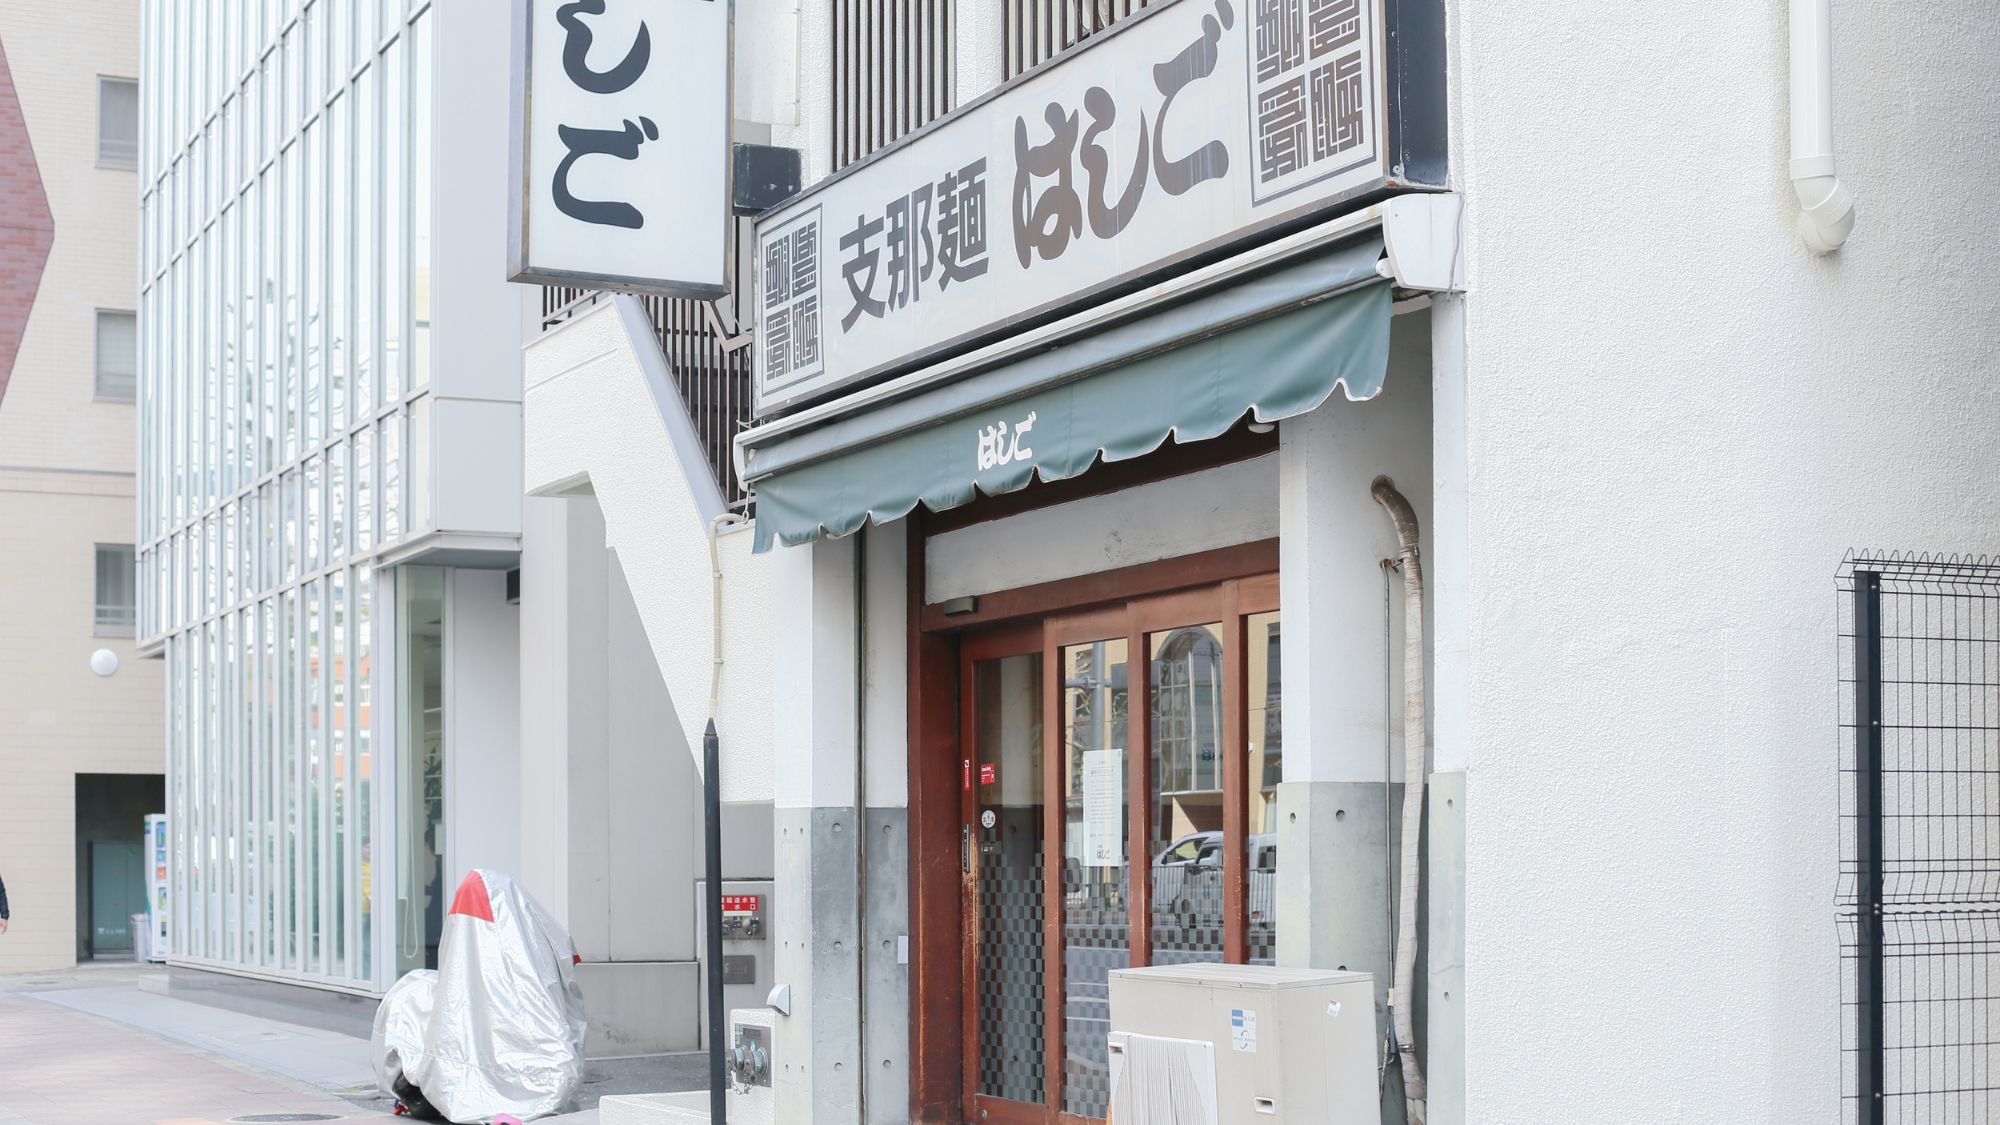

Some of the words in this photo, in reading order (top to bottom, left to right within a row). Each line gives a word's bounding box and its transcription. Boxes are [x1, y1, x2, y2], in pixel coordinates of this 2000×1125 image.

[839, 156, 989, 334] 支那麺
[1012, 0, 1234, 270] はしご
[978, 410, 1037, 472] はしご
